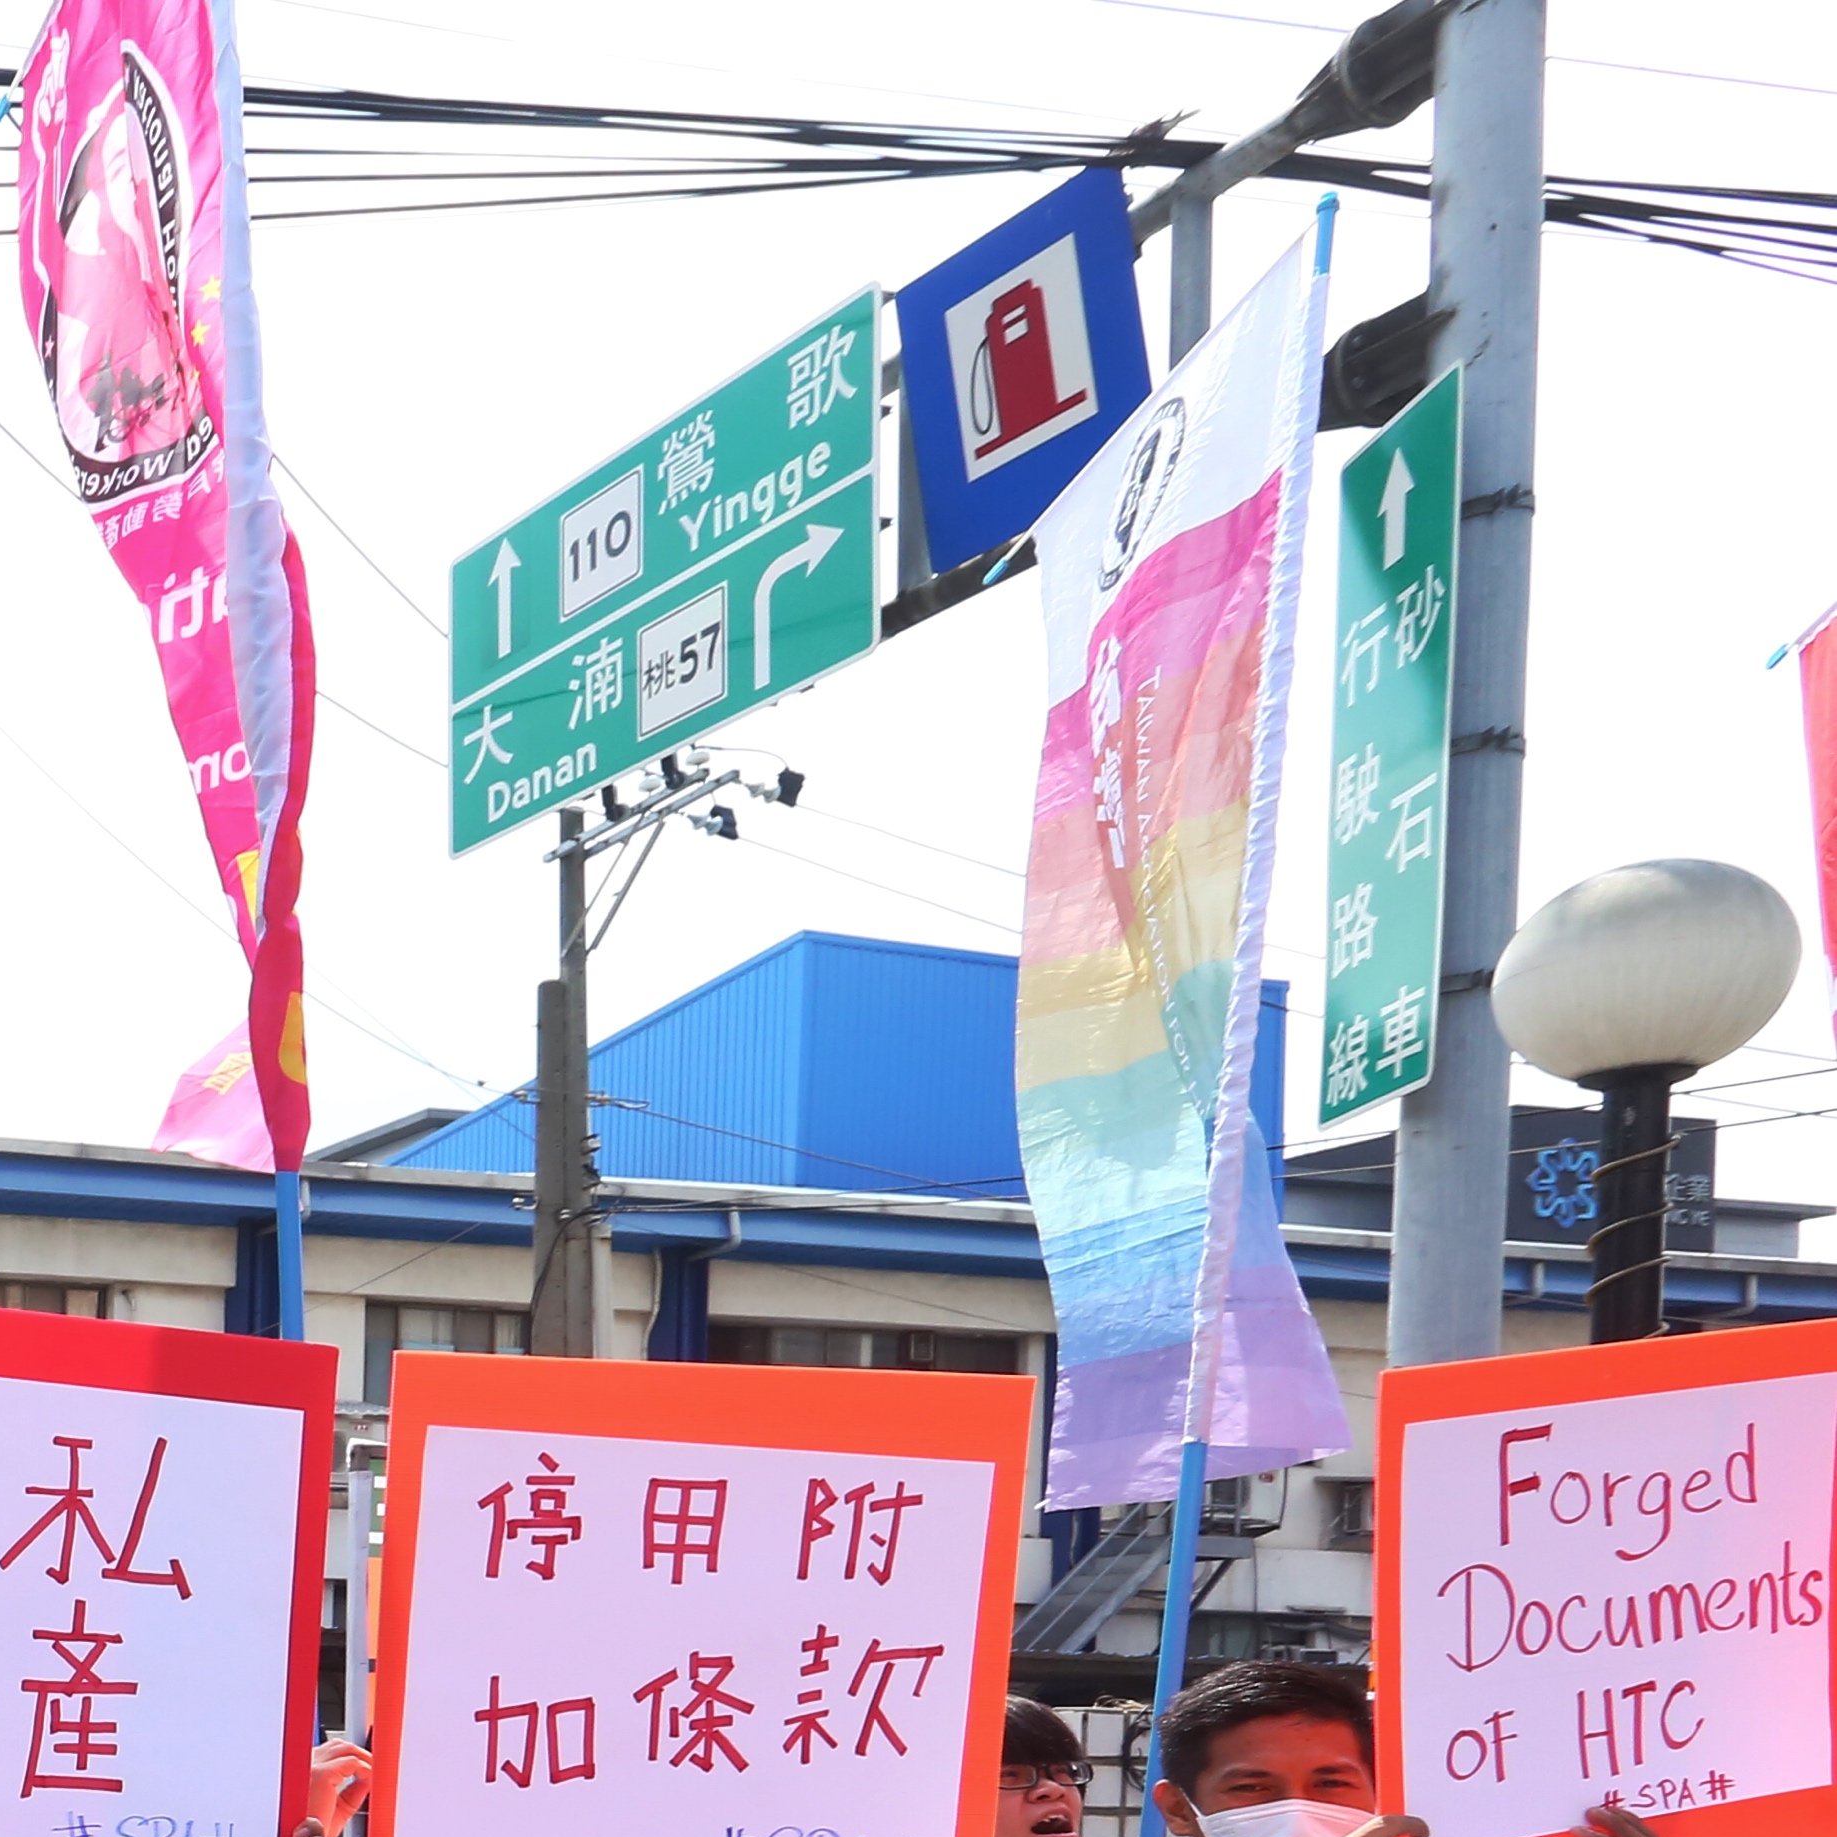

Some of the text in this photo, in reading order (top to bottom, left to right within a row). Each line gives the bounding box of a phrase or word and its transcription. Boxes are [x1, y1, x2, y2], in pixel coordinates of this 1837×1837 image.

[657, 324, 859, 515] 鶯歌
[568, 509, 632, 584] 110
[678, 440, 832, 553] Yingge
[462, 635, 625, 786] 大湳
[641, 619, 723, 699] 桃57
[486, 741, 597, 824] Danan
[1375, 563, 1446, 1080] 砂石車
[1326, 601, 1390, 1108] 行駛路線
[1499, 1421, 1759, 1562] Forged
[1436, 1539, 1825, 1674] Documents
[474, 1623, 945, 1789] 加條款
[1576, 1678, 1706, 1780] HTC
